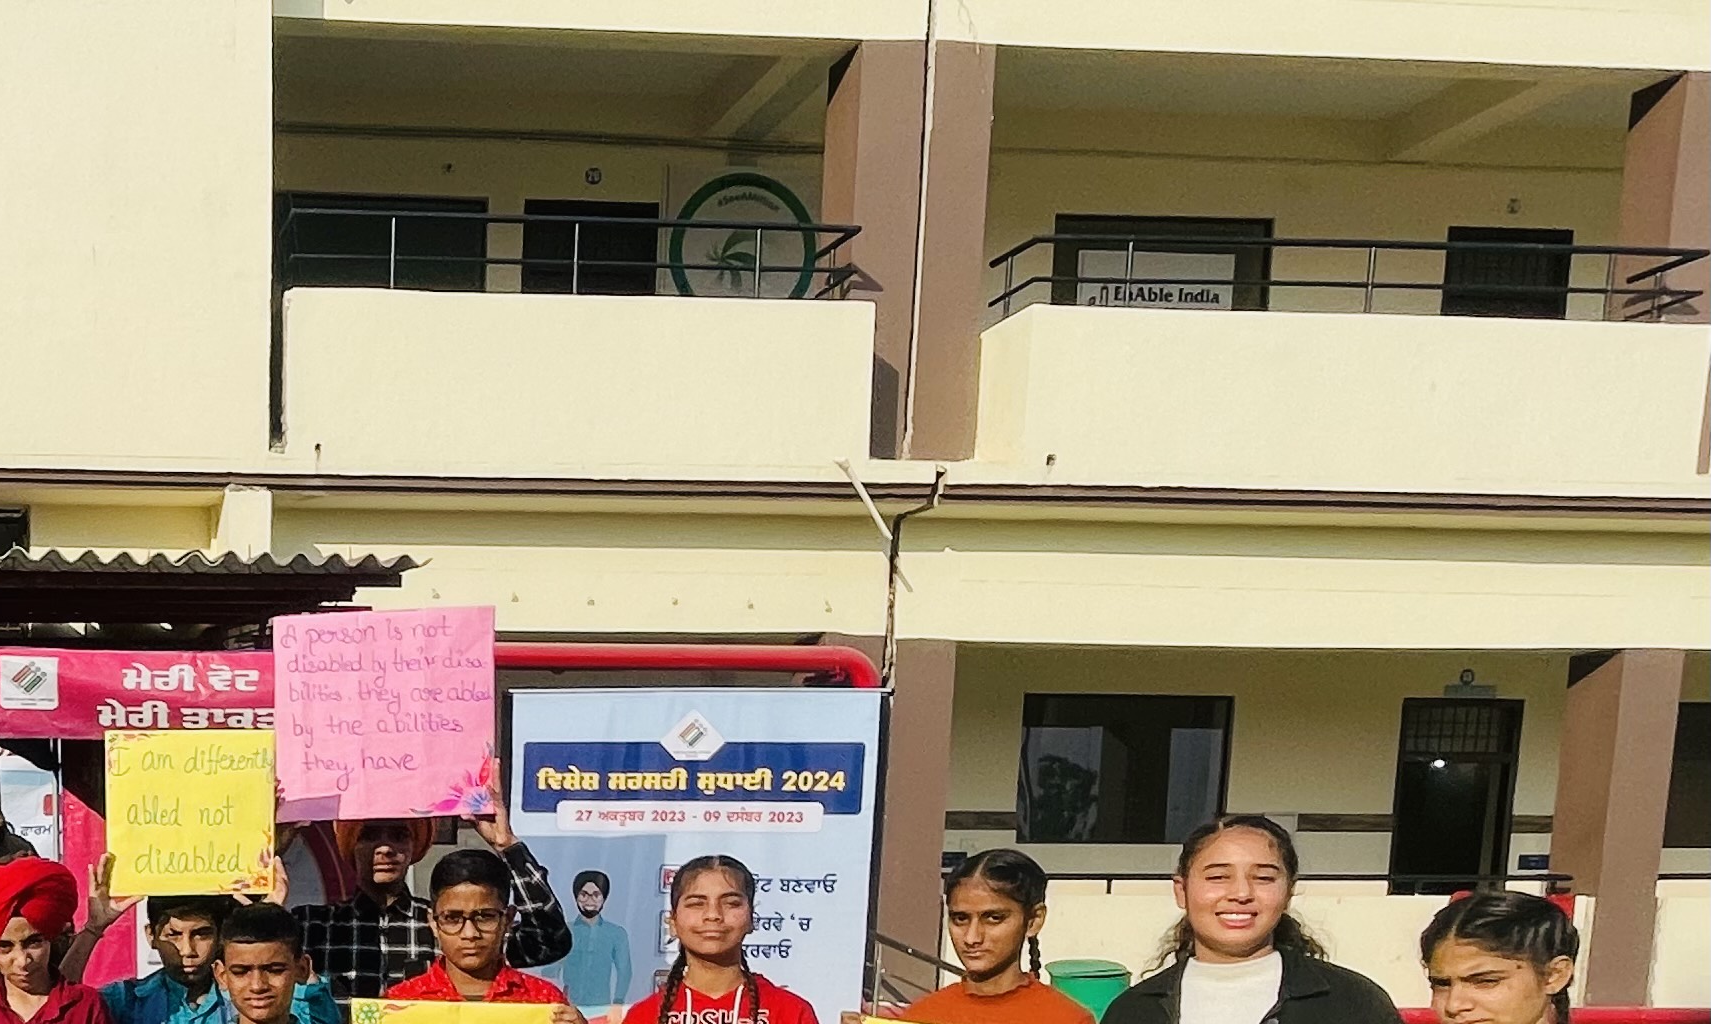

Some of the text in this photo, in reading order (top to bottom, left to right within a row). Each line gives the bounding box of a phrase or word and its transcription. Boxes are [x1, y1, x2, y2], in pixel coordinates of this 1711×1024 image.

[1178, 287, 1220, 304] India
[305, 624, 375, 656] person
[411, 615, 453, 638] not
[122, 662, 260, 692] ਮੇਰੀ ਵੋਟ
[287, 652, 368, 673] disabled
[371, 653, 387, 688] by
[357, 680, 401, 714] they
[96, 698, 170, 729] ਮੇਰੀ
[291, 713, 314, 748] by
[377, 712, 464, 735] abilities
[141, 750, 175, 771] am
[361, 749, 419, 771] have
[607, 766, 689, 792] ਸਰਸਰੀ
[697, 766, 773, 796] ਸੁਧਾਈ
[780, 770, 846, 792] 2024
[126, 794, 234, 827] abled not
[575, 810, 593, 822] 27
[598, 810, 645, 827] ਅਕਤੂਬਰ
[651, 810, 685, 822] 2023
[703, 810, 721, 822] 09
[768, 811, 803, 823] 2023
[780, 873, 838, 893] ਬਣਵਾਓ
